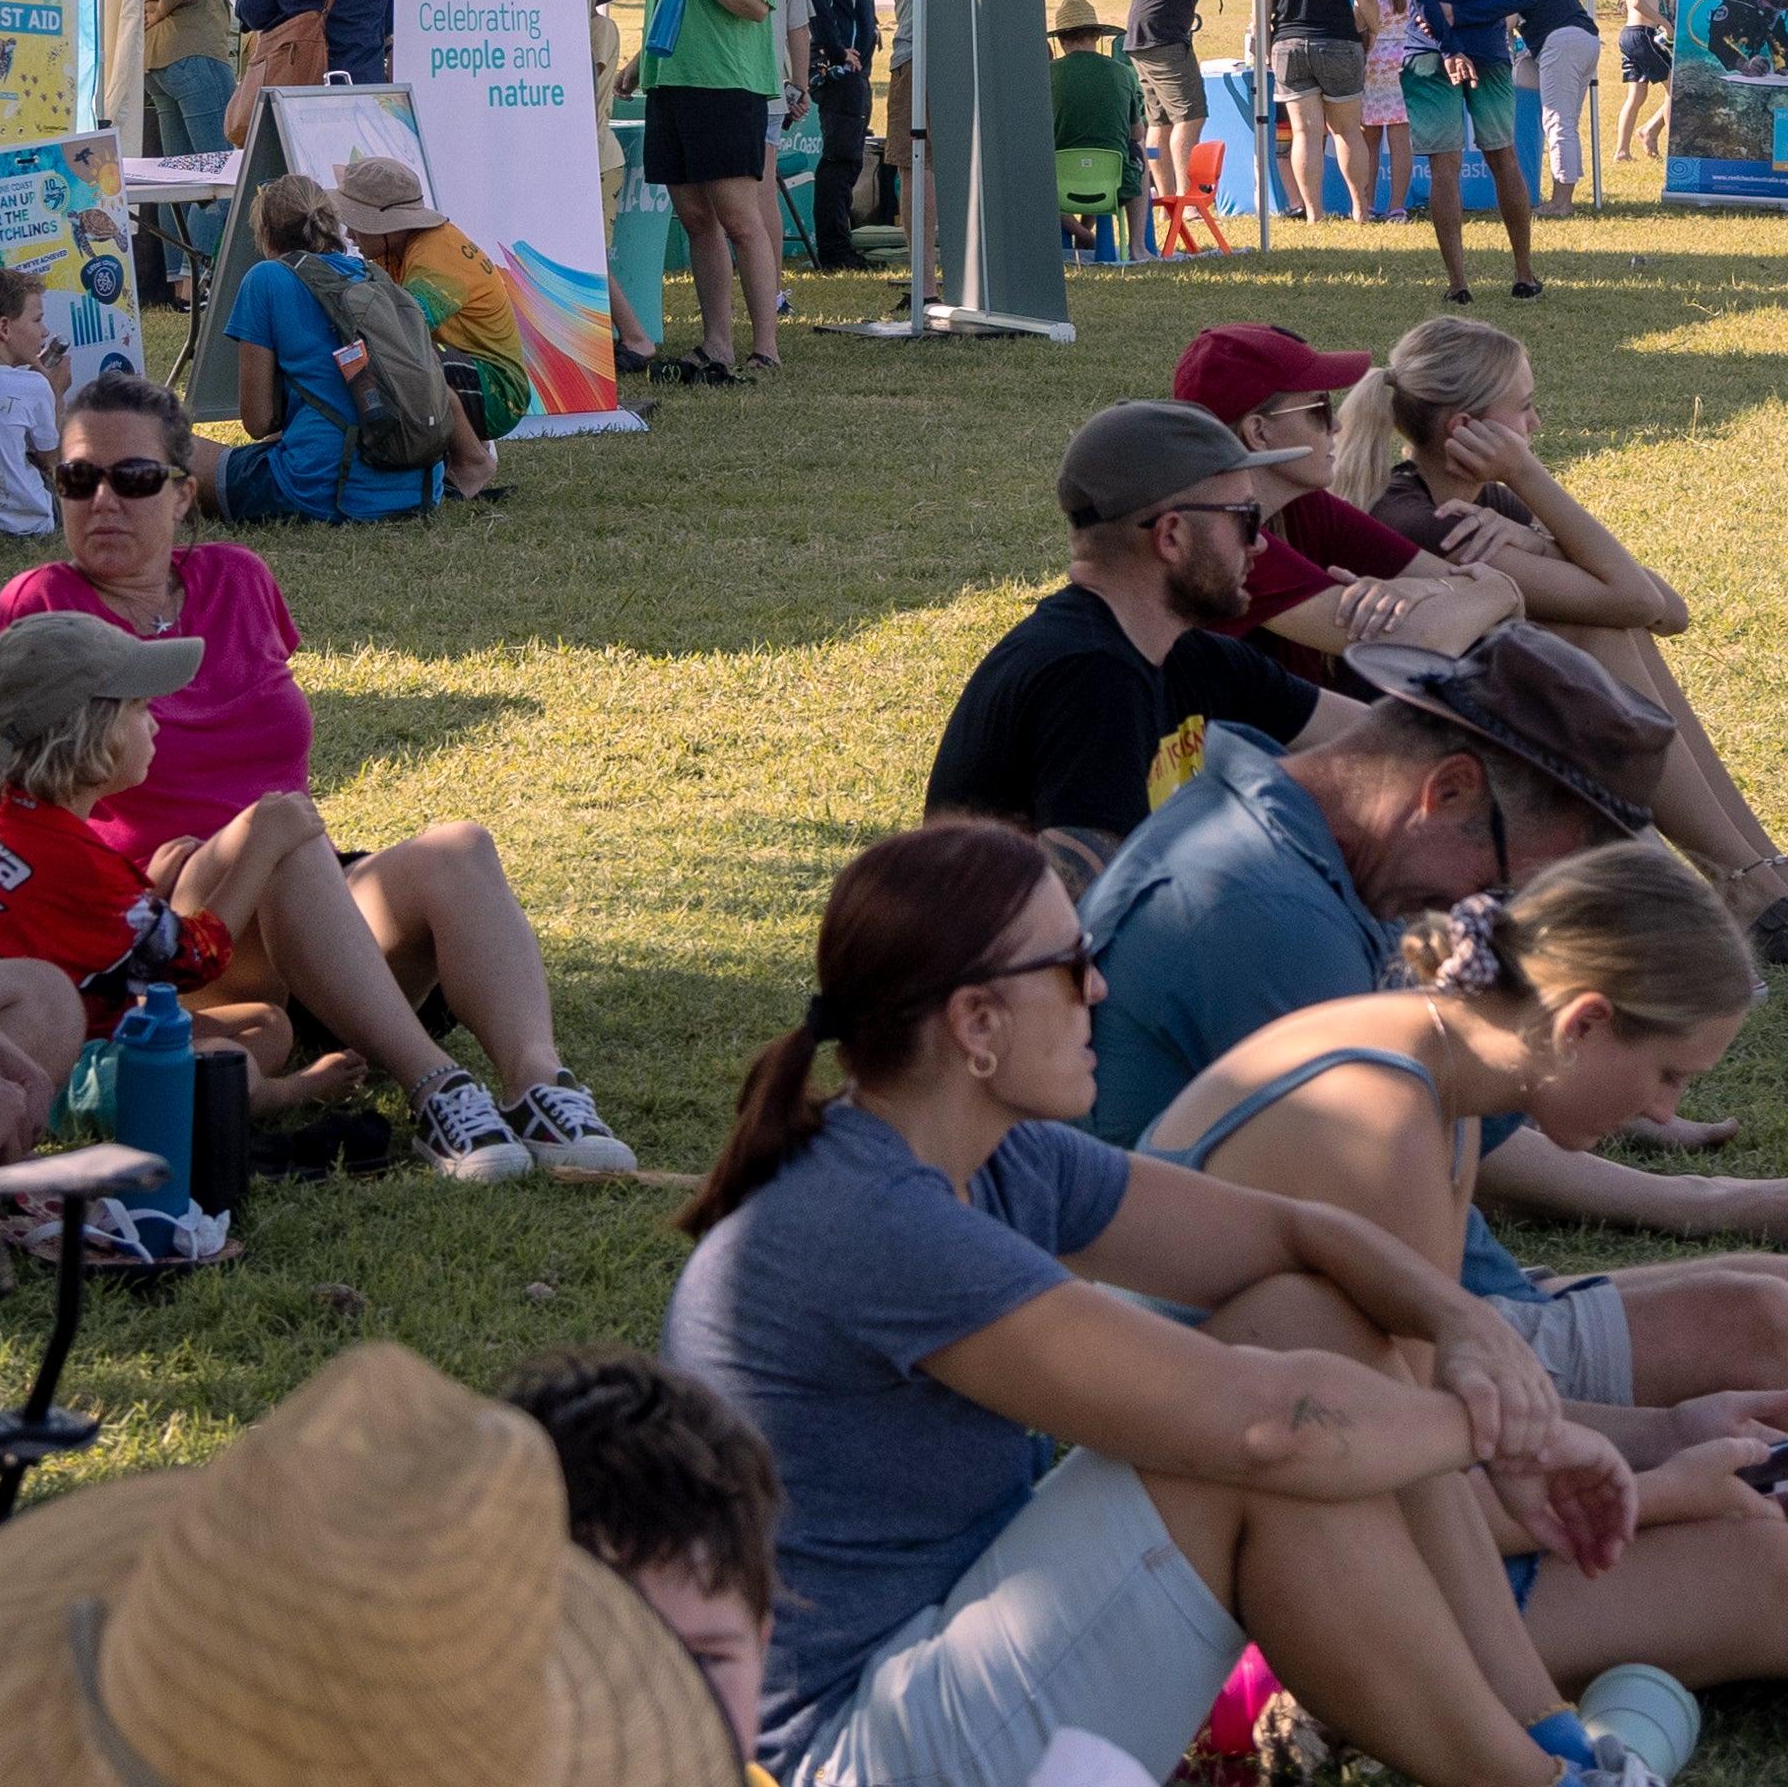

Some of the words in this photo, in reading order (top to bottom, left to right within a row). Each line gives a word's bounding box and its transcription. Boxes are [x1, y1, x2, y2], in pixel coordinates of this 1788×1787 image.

[28, 9, 61, 32] AID
[419, 0, 542, 40] Celebrating
[431, 39, 506, 79] people
[513, 38, 551, 69] and
[488, 78, 565, 108] nature
[11, 180, 33, 191] COAST
[20, 191, 36, 206] UP
[4, 209, 30, 224] THE
